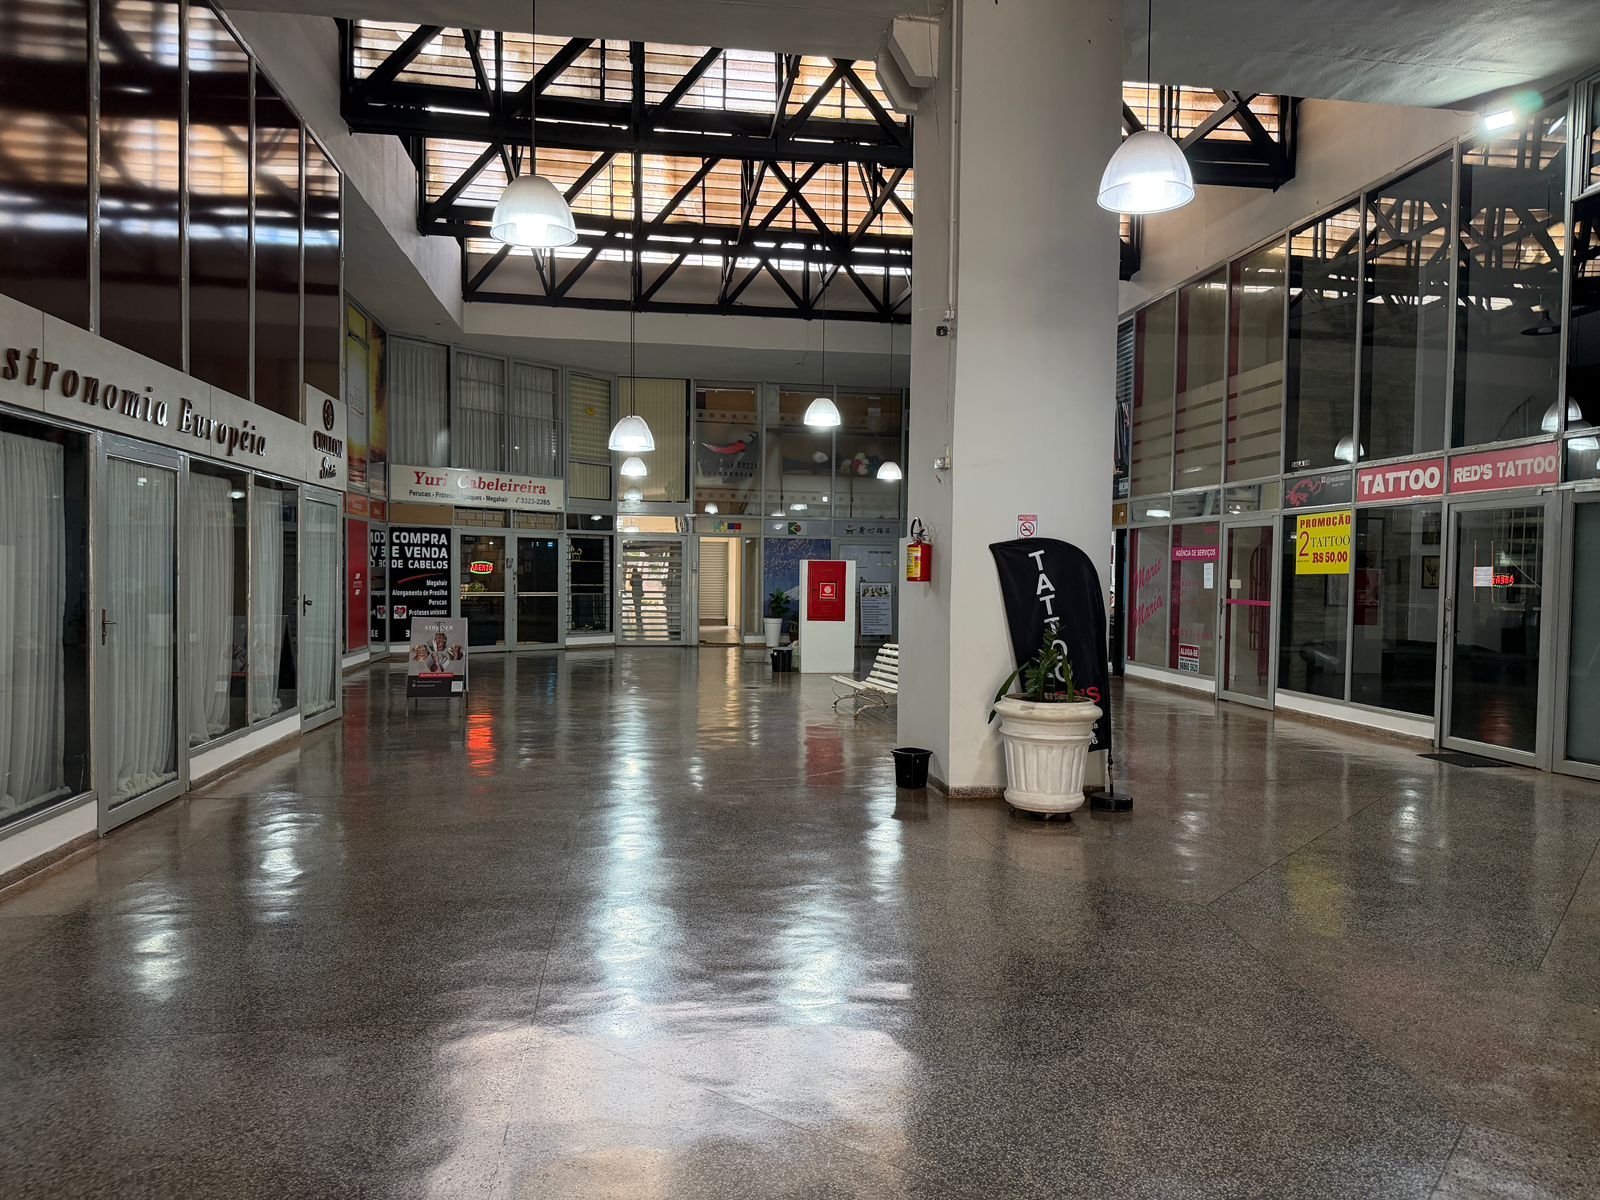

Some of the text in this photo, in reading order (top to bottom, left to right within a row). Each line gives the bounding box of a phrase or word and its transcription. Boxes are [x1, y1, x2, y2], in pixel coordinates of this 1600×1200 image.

[178, 397, 267, 457] Européia
[1453, 455, 1557, 484] RED'S TATTOO
[413, 471, 547, 495] Yuri Cabeleireira
[1361, 466, 1441, 495] TATTOO
[409, 489, 431, 498] Perucas
[486, 495, 509, 503] Megahair
[1300, 514, 1351, 528] PROMOÇÃO
[392, 531, 448, 545] COMPRA
[1299, 531, 1351, 557] 2 TATTOO
[391, 546, 400, 558] E
[404, 546, 448, 559] VENDA
[391, 559, 449, 569] DE CABELOS
[470, 563, 493, 572] ABERTO
[426, 579, 448, 587] Megahair
[391, 589, 423, 598] Alongamento
